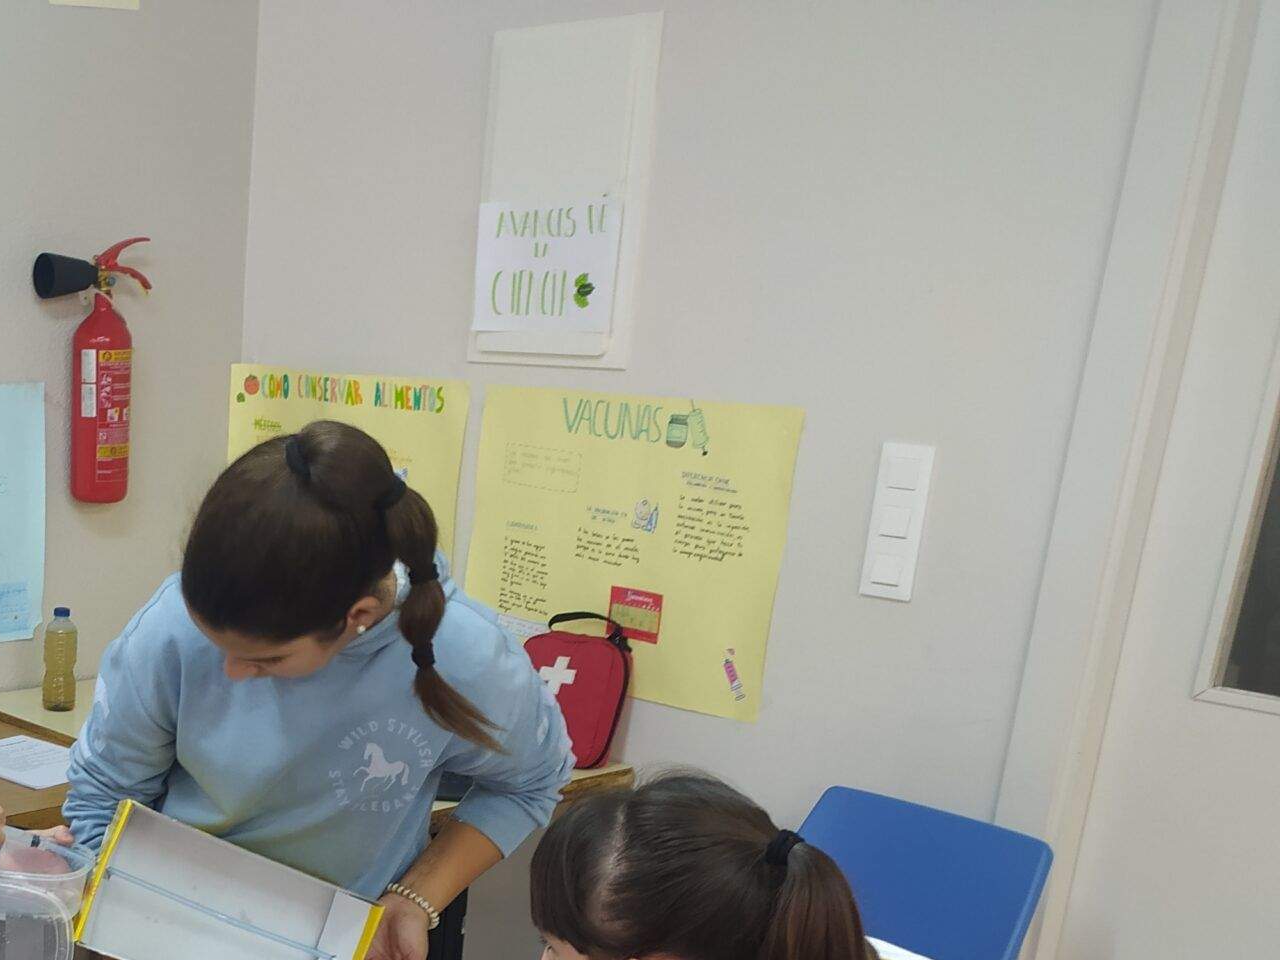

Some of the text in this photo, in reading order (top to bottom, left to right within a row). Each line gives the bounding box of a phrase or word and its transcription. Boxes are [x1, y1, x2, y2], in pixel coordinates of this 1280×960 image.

[261, 373, 445, 414] COMO CONSERVAR ALIMENTOS
[562, 397, 664, 443] VACUNAS
[338, 718, 434, 768] WILD STYLISH
